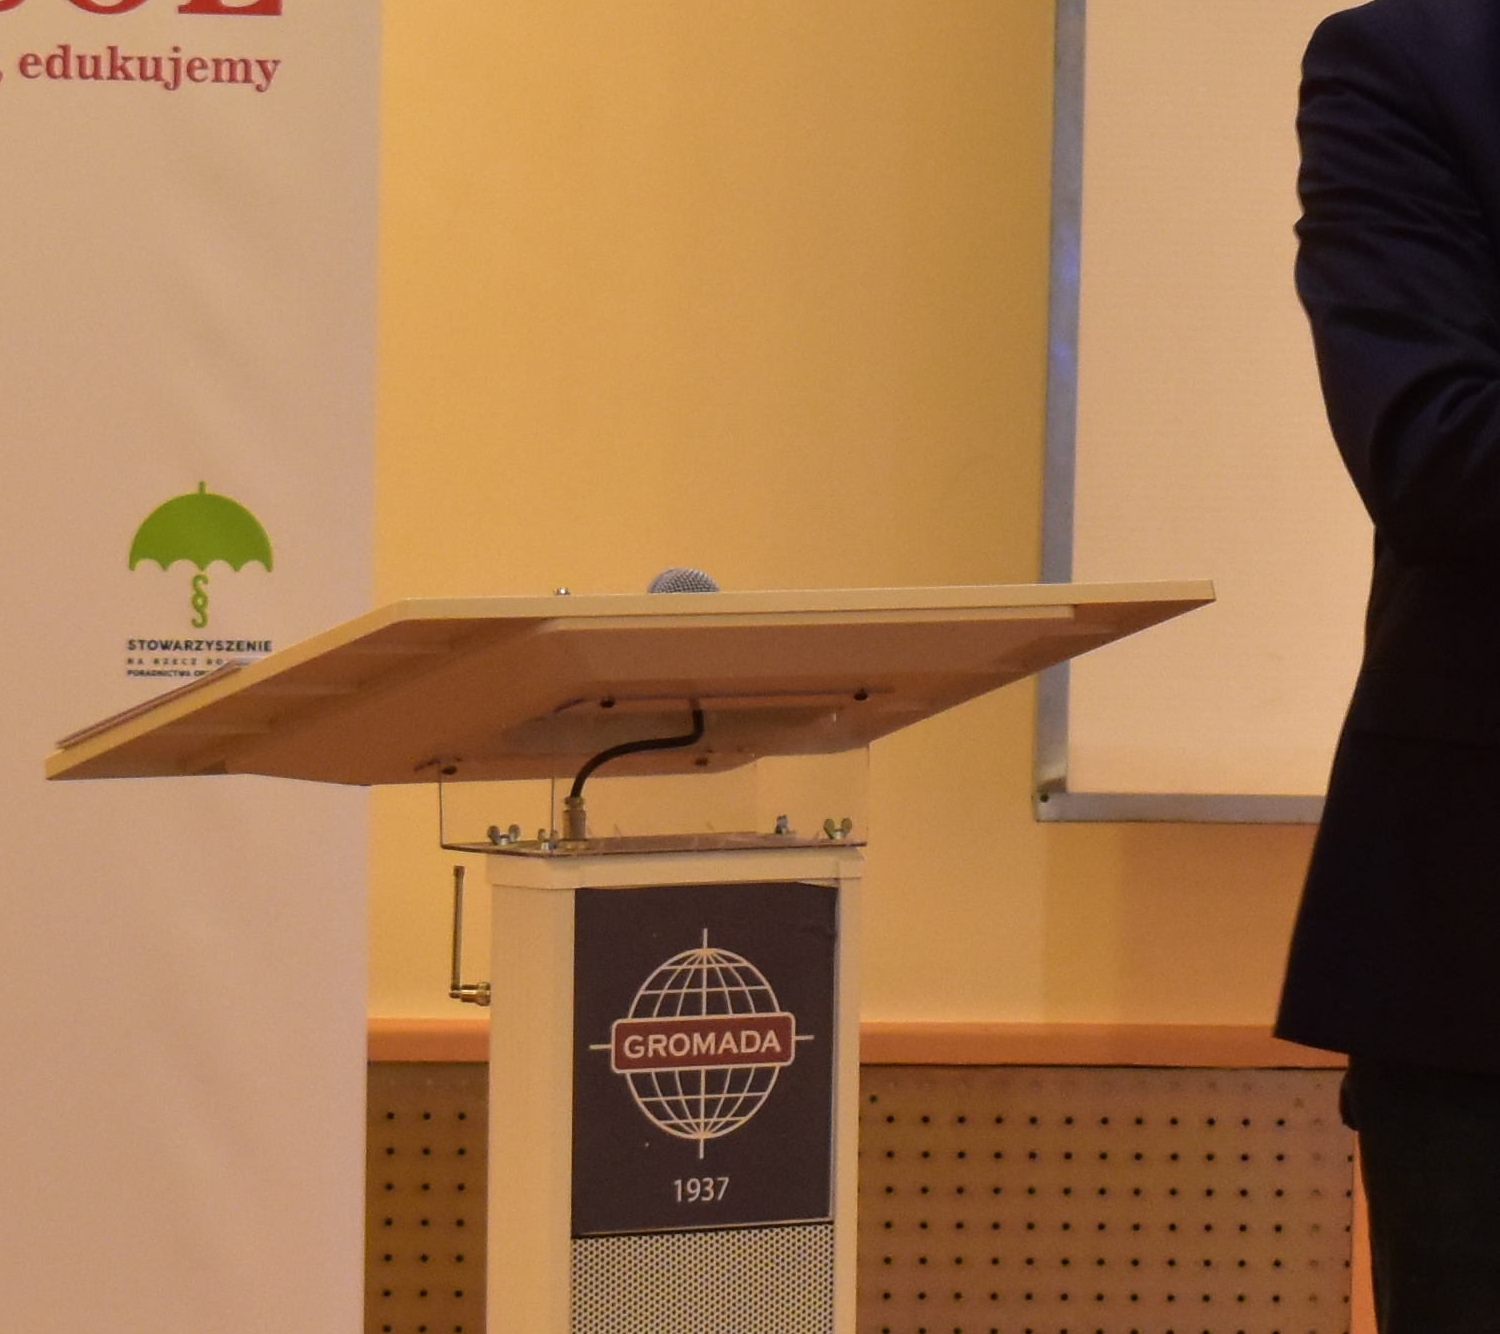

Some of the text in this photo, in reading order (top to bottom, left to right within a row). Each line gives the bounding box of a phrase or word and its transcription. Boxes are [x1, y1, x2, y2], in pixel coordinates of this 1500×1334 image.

[18, 43, 282, 94] edukujemy
[127, 639, 272, 652] STOWARZYSZENIE
[624, 1029, 781, 1059] GROMADA
[674, 1177, 729, 1203] 1937
